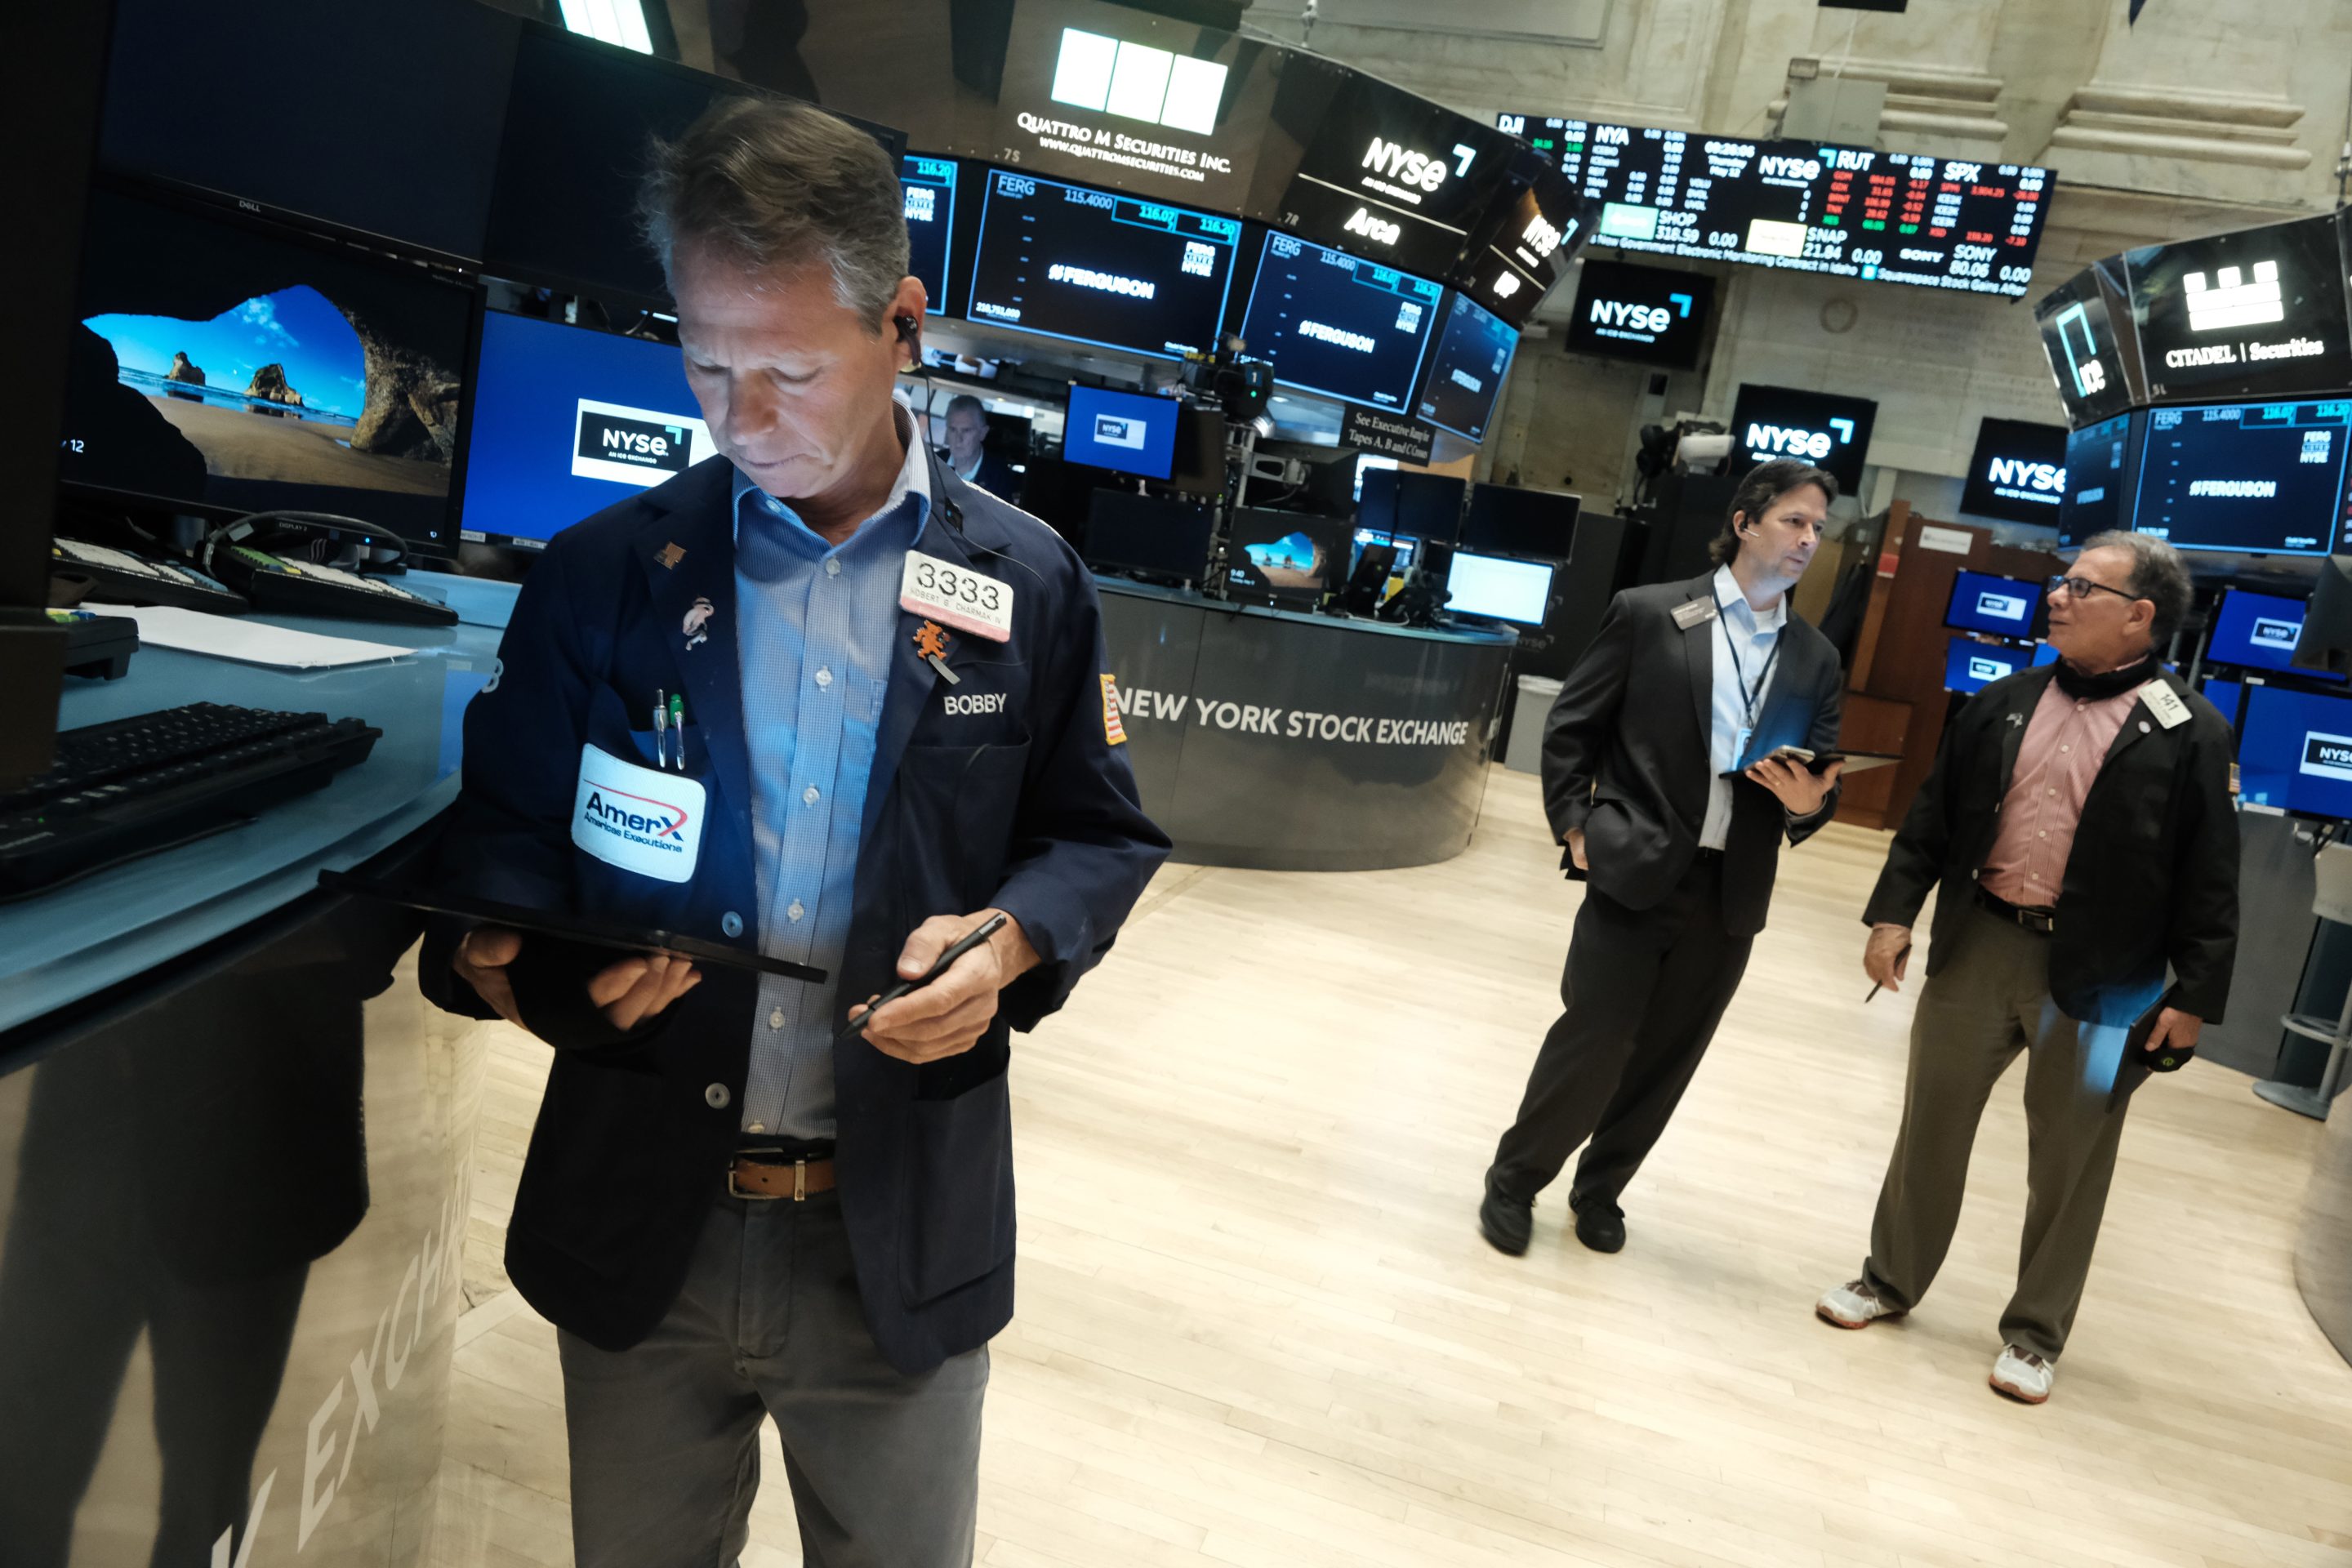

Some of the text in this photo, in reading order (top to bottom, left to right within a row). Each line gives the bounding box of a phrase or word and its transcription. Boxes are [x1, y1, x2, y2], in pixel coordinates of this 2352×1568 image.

[1499, 115, 1525, 134] DJI
[1017, 112, 1232, 173] QUATTRO M SECURITIES INC.
[1595, 126, 1628, 145] NYA
[1004, 148, 1021, 162] 7S
[1837, 150, 1875, 171] RUT
[917, 162, 951, 176] 116.20
[1944, 162, 1981, 182] SPX
[906, 187, 935, 201] FERG
[238, 200, 261, 213] DELL
[998, 175, 1235, 235] FERG 115.4000 116.07 116.20
[1285, 212, 1299, 226] 7R
[1344, 207, 1401, 245] Arca
[1658, 211, 1697, 227] SHOP
[1272, 235, 1302, 256] FERG
[1655, 225, 1738, 247] 318.59 0.00
[1806, 227, 1847, 244] SNAP
[1186, 241, 1215, 257] FERG
[1620, 238, 1675, 253] Government
[1677, 243, 1722, 259] Electronic
[1723, 250, 1775, 268] Monitoring
[1775, 255, 1818, 271] Contract
[1819, 261, 1829, 271] in
[1829, 262, 1858, 275] Idaho
[1802, 243, 1882, 265] 21.84 0.00
[1900, 248, 1944, 262] SONY
[1953, 244, 1998, 261] SONY
[1049, 264, 1155, 299] #FERGUSON
[1949, 260, 2031, 283] 80.06 0.00
[1298, 320, 1375, 353] #FERGUSON
[2166, 337, 2324, 368] CITADEL Securities
[1251, 372, 1257, 383] 1
[1355, 412, 1371, 426] See
[1372, 416, 1410, 436] Executive
[2154, 412, 2183, 425] FERG
[70, 439, 85, 453] 12
[1348, 428, 1374, 446] Tapes
[1374, 436, 1383, 449] A,
[1384, 438, 1392, 450] B
[1392, 442, 1407, 454] and
[2189, 480, 2276, 497] #FERGUSON
[917, 563, 999, 611] 3333
[943, 693, 1007, 715] BOBBY
[2160, 693, 2179, 711] 141
[1112, 687, 1188, 722] NEW
[1195, 697, 1282, 735] YORK
[1285, 711, 1374, 744] STOCK
[1376, 719, 1469, 746] EXCHANGE
[586, 791, 685, 842] AmerX
[584, 812, 683, 853] Americas Executions
